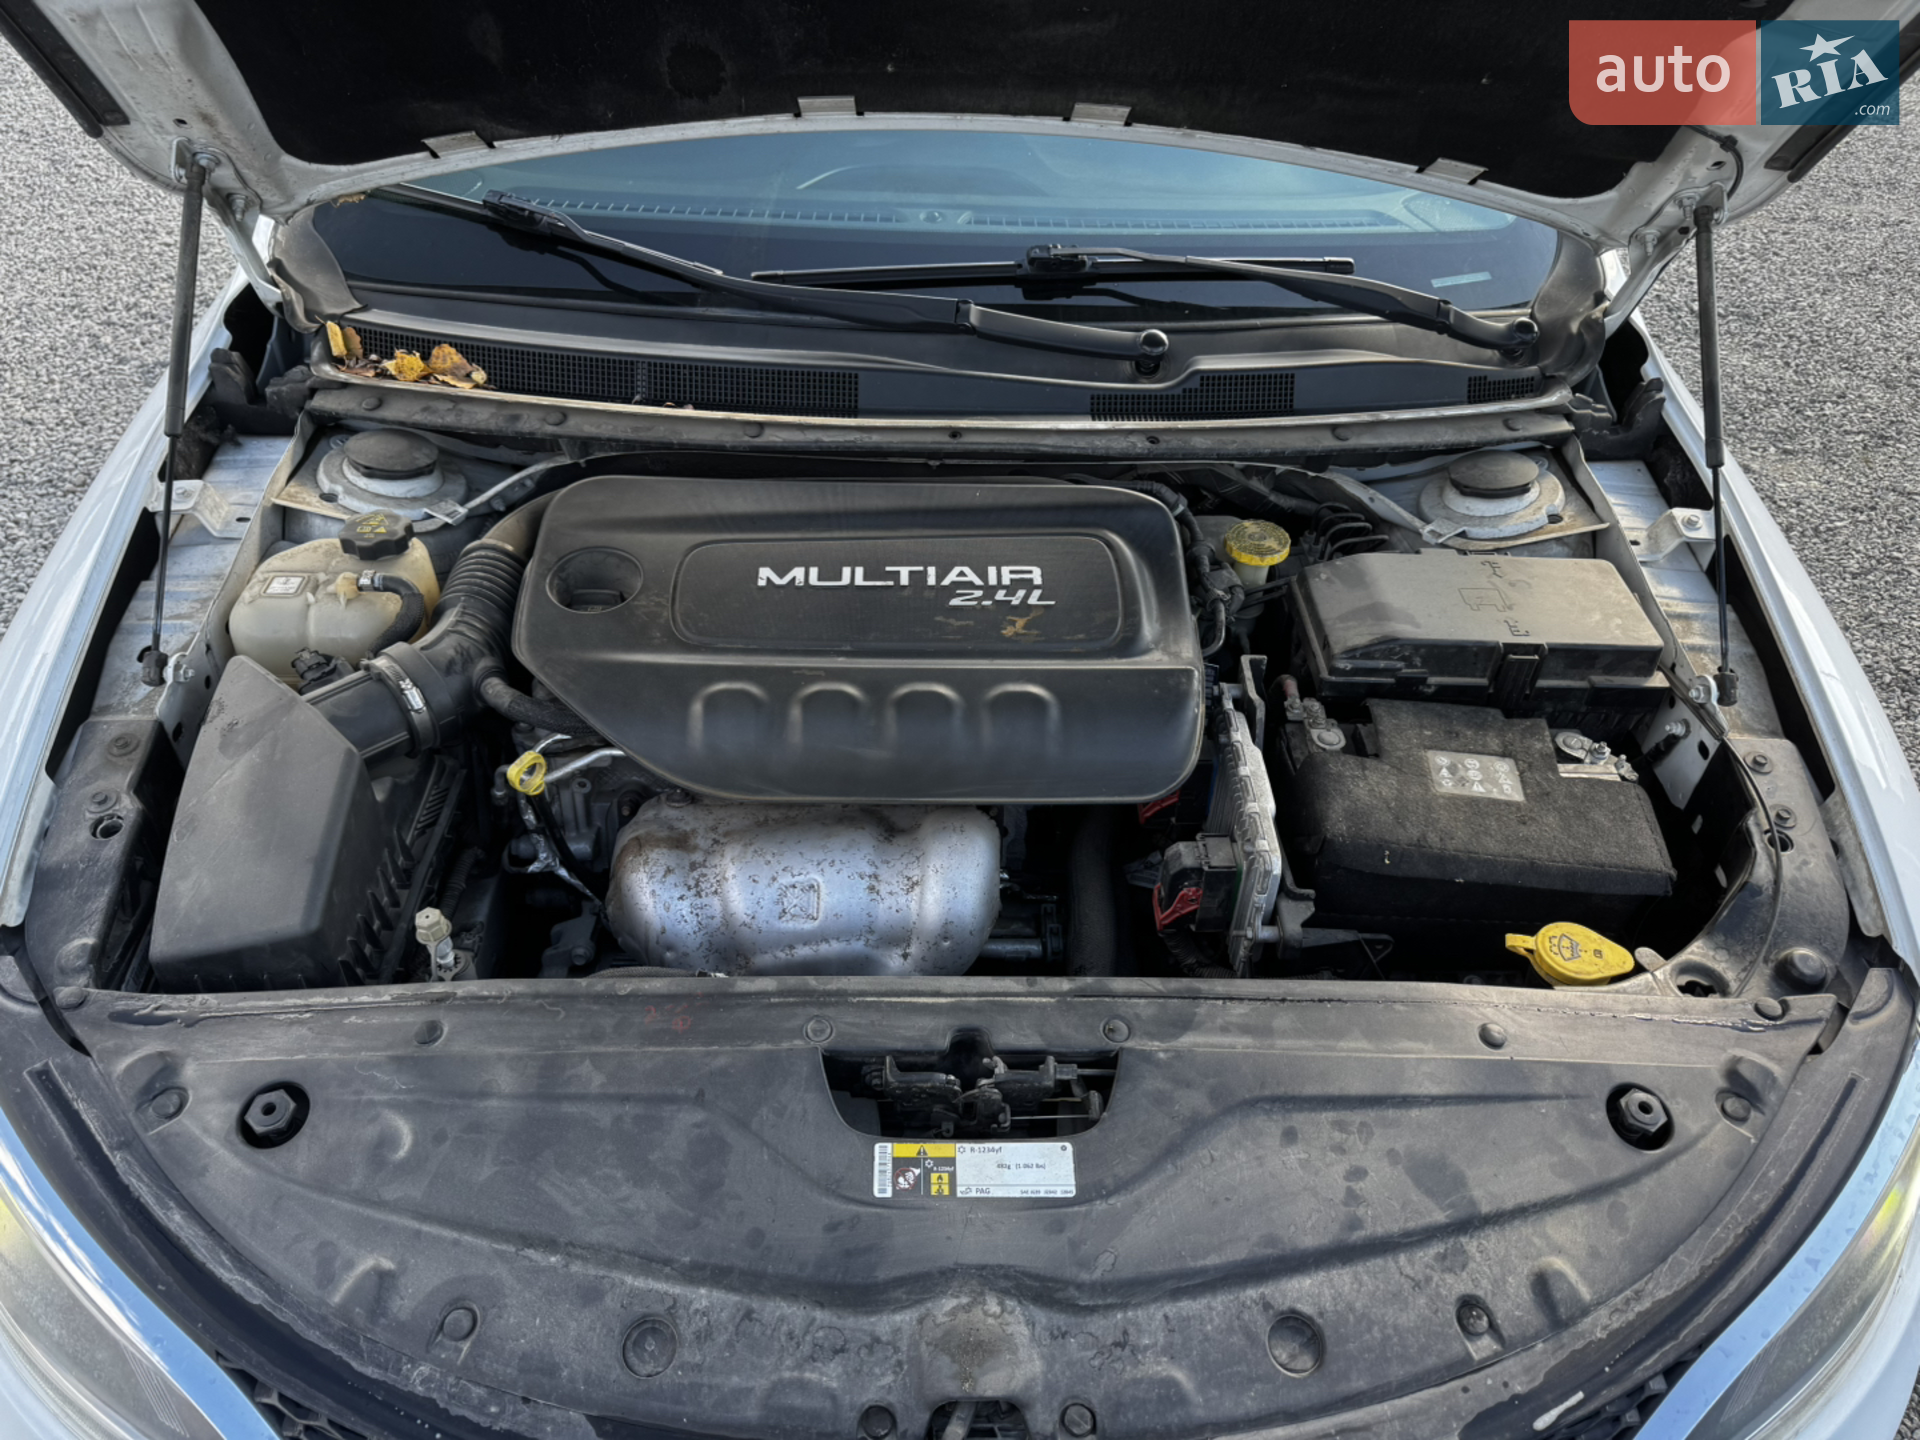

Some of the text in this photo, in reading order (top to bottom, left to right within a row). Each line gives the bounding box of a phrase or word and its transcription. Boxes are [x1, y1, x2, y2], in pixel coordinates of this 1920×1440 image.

[757, 566, 1043, 586] MULTIAIR
[949, 589, 1056, 606] 2.4L
[975, 1187, 991, 1195] PAG
